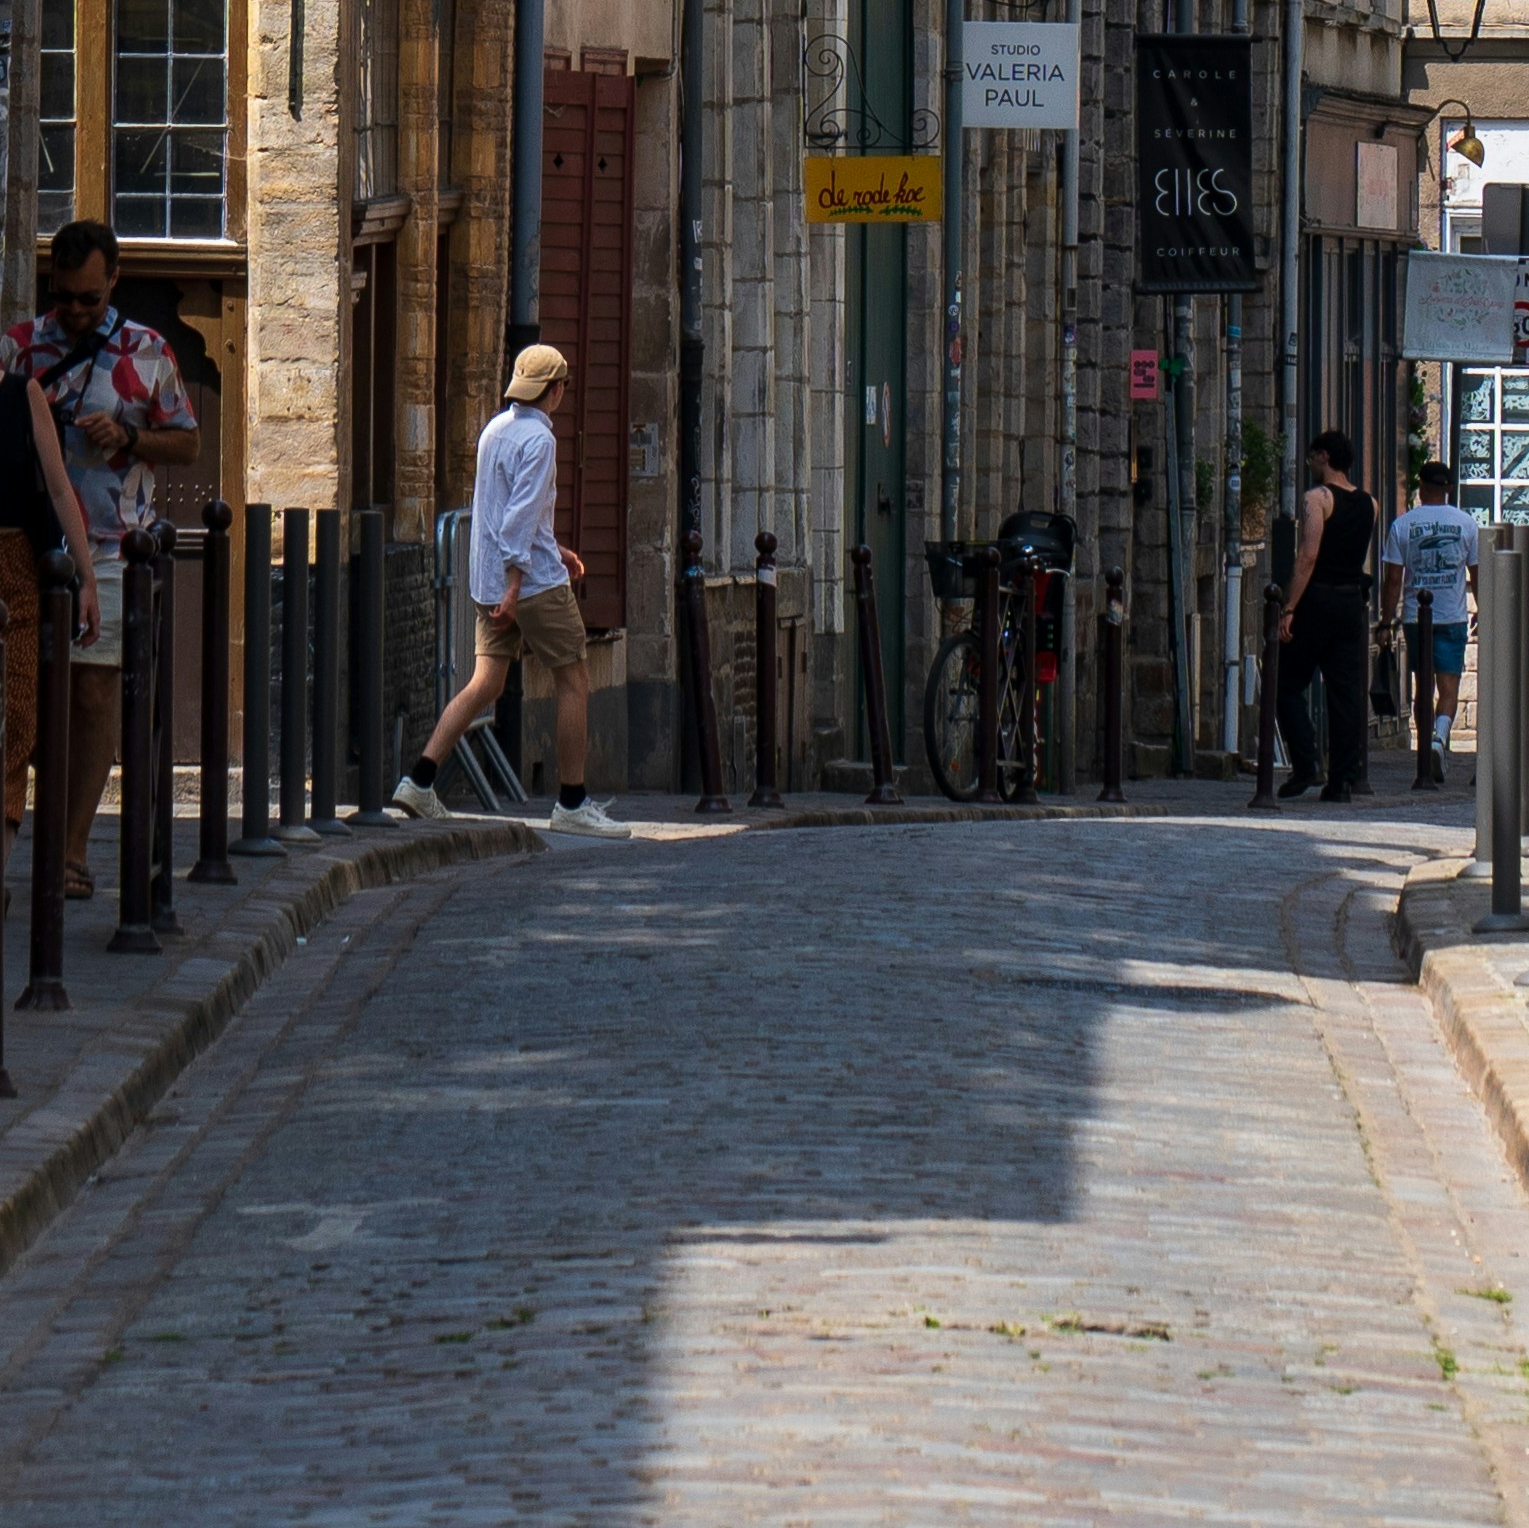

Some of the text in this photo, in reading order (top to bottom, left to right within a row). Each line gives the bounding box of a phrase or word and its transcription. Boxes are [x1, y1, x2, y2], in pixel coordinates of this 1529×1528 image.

[991, 44, 1041, 56] STUDIO
[966, 62, 1065, 82] VALERIA
[1152, 69, 1237, 80] CAROLE
[985, 88, 1045, 108] PAUL
[1190, 97, 1198, 107] &
[1156, 246, 1241, 257] COIFFEUR
